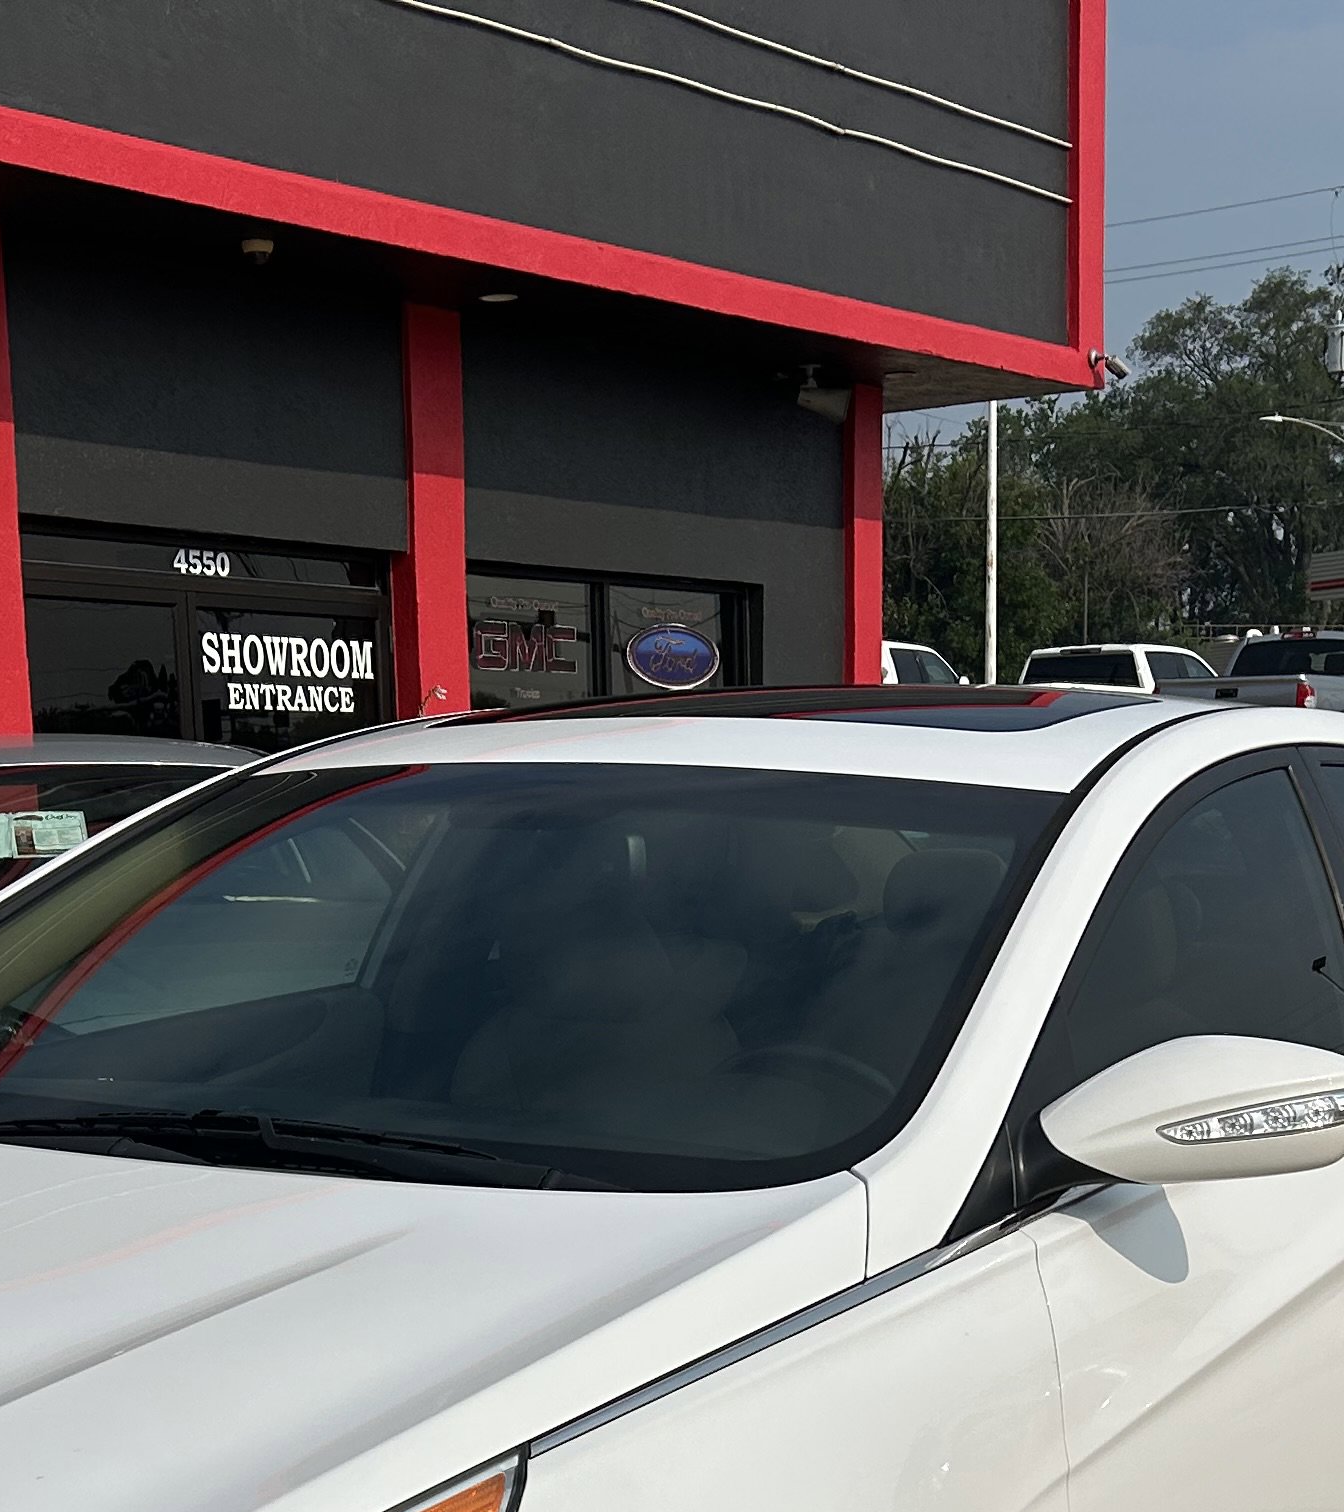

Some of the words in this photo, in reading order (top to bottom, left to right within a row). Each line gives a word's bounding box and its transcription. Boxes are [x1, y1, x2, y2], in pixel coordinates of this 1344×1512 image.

[173, 549, 230, 577] 4550
[201, 632, 375, 680] SHOWROOM
[474, 620, 577, 674] GMC
[649, 630, 698, 674] Ford
[227, 683, 355, 713] ENTRANCE
